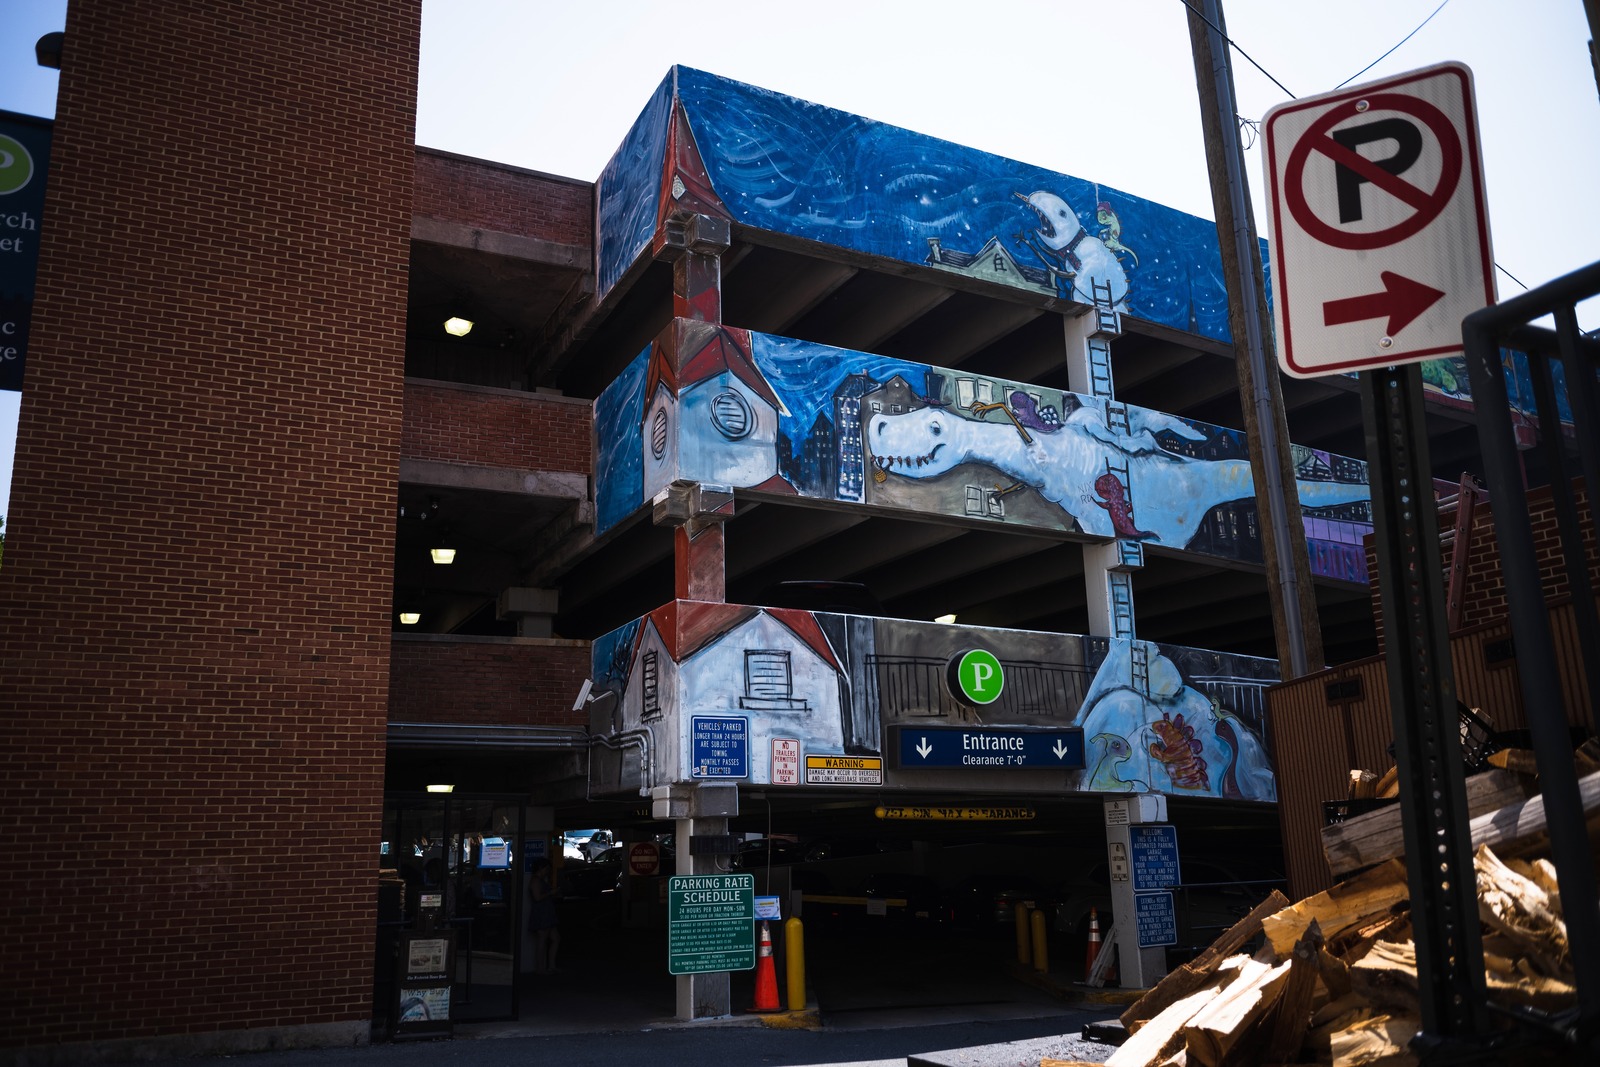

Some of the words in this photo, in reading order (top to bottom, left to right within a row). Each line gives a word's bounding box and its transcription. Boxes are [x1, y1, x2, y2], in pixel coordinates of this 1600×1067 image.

[971, 663, 993, 692] P
[963, 734, 1024, 750] Entrance
[826, 759, 864, 768] WARNING
[963, 756, 1004, 765] Clearance
[674, 878, 719, 890] PARKING
[725, 877, 749, 888] RATE
[684, 891, 740, 903] SCHEDULE
